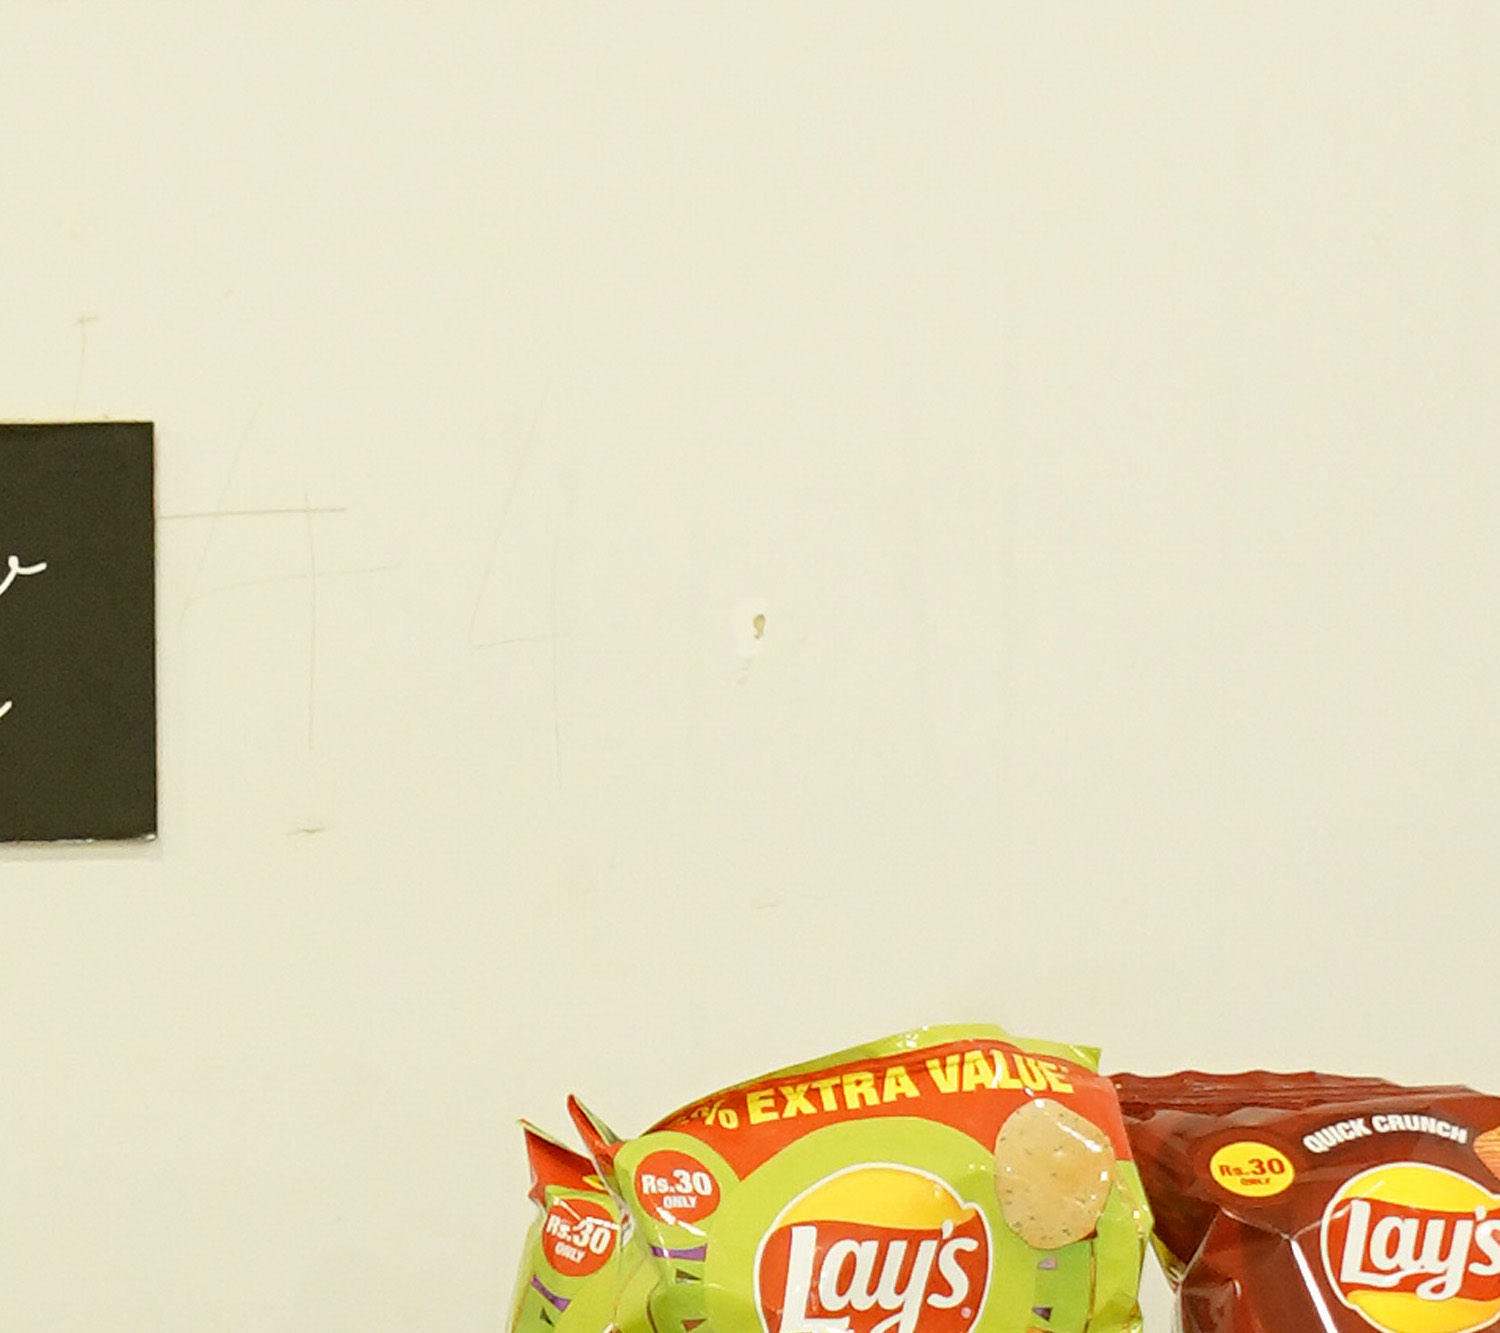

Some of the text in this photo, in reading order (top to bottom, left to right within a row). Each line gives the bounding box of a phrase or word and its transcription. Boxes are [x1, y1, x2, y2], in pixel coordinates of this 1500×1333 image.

[746, 1065, 921, 1126] EXTRA
[1302, 1112, 1469, 1154] QUICK CRUNCH
[642, 1169, 712, 1198] Rs.30
[662, 1194, 698, 1211] ONLY
[546, 1214, 611, 1255] Rs.30
[555, 1241, 586, 1264] ONLY
